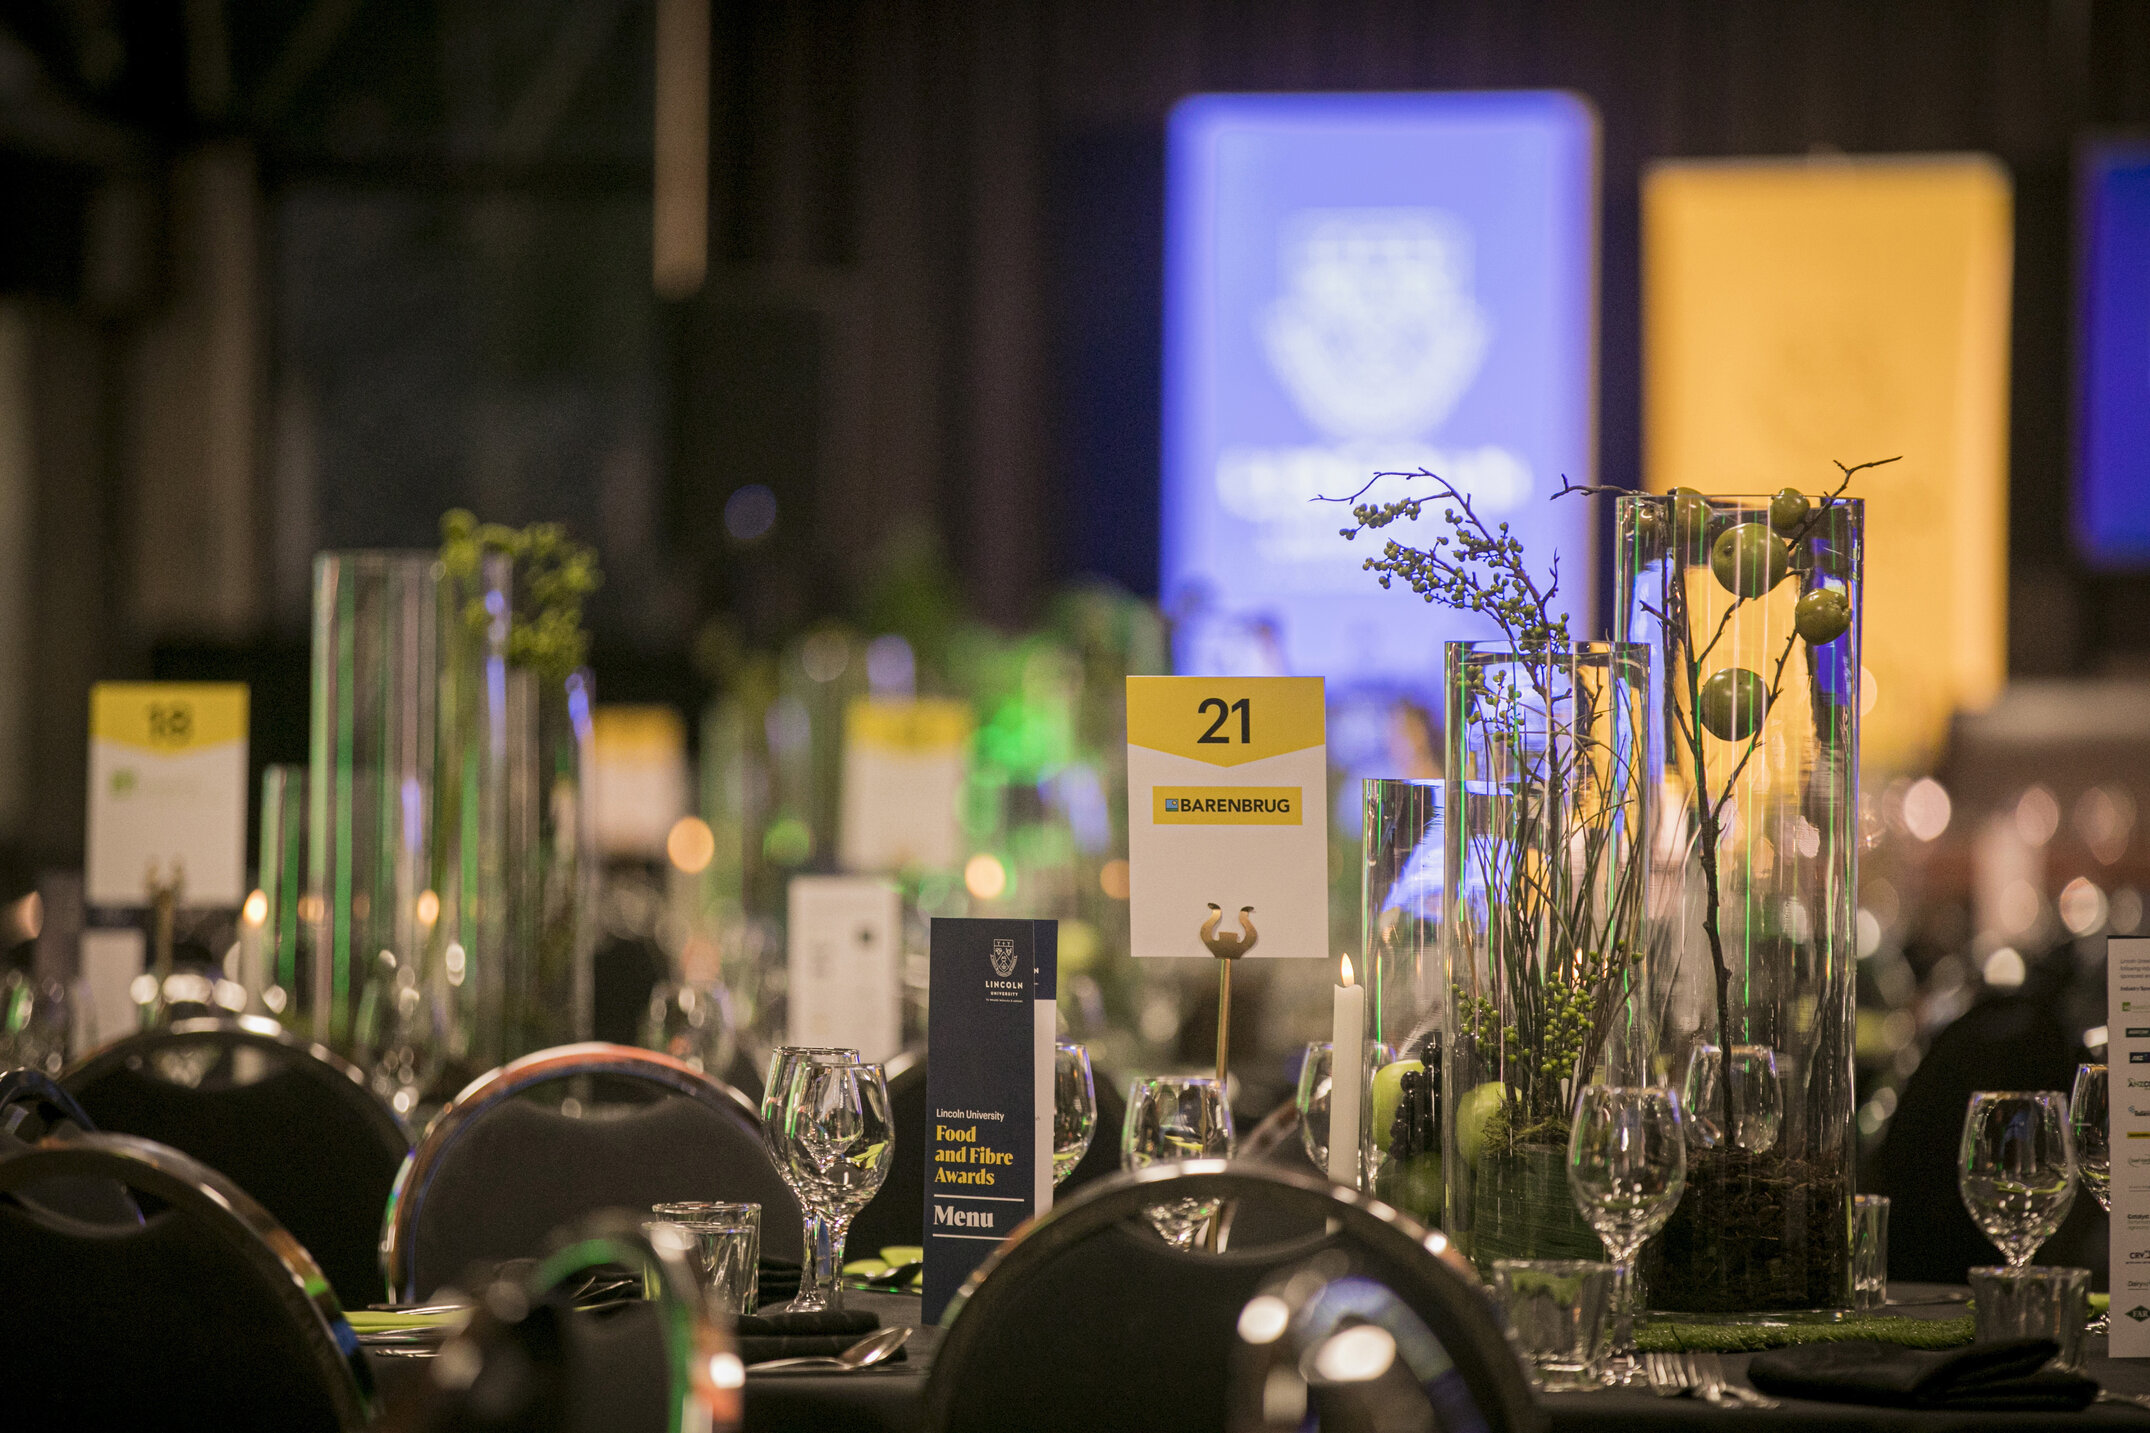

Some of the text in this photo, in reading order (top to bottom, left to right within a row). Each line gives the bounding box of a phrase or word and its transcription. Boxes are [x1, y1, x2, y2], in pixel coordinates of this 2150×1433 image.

[1196, 697, 1251, 744] 21
[1180, 798, 1290, 813] BARENBRUG
[985, 980, 1023, 989] LINCOLN
[936, 1108, 1005, 1123] Lincoln University
[935, 1124, 977, 1143] Food
[934, 1146, 1014, 1166] and Fibre
[934, 1167, 995, 1186] Awards
[933, 1205, 994, 1228] Menu
